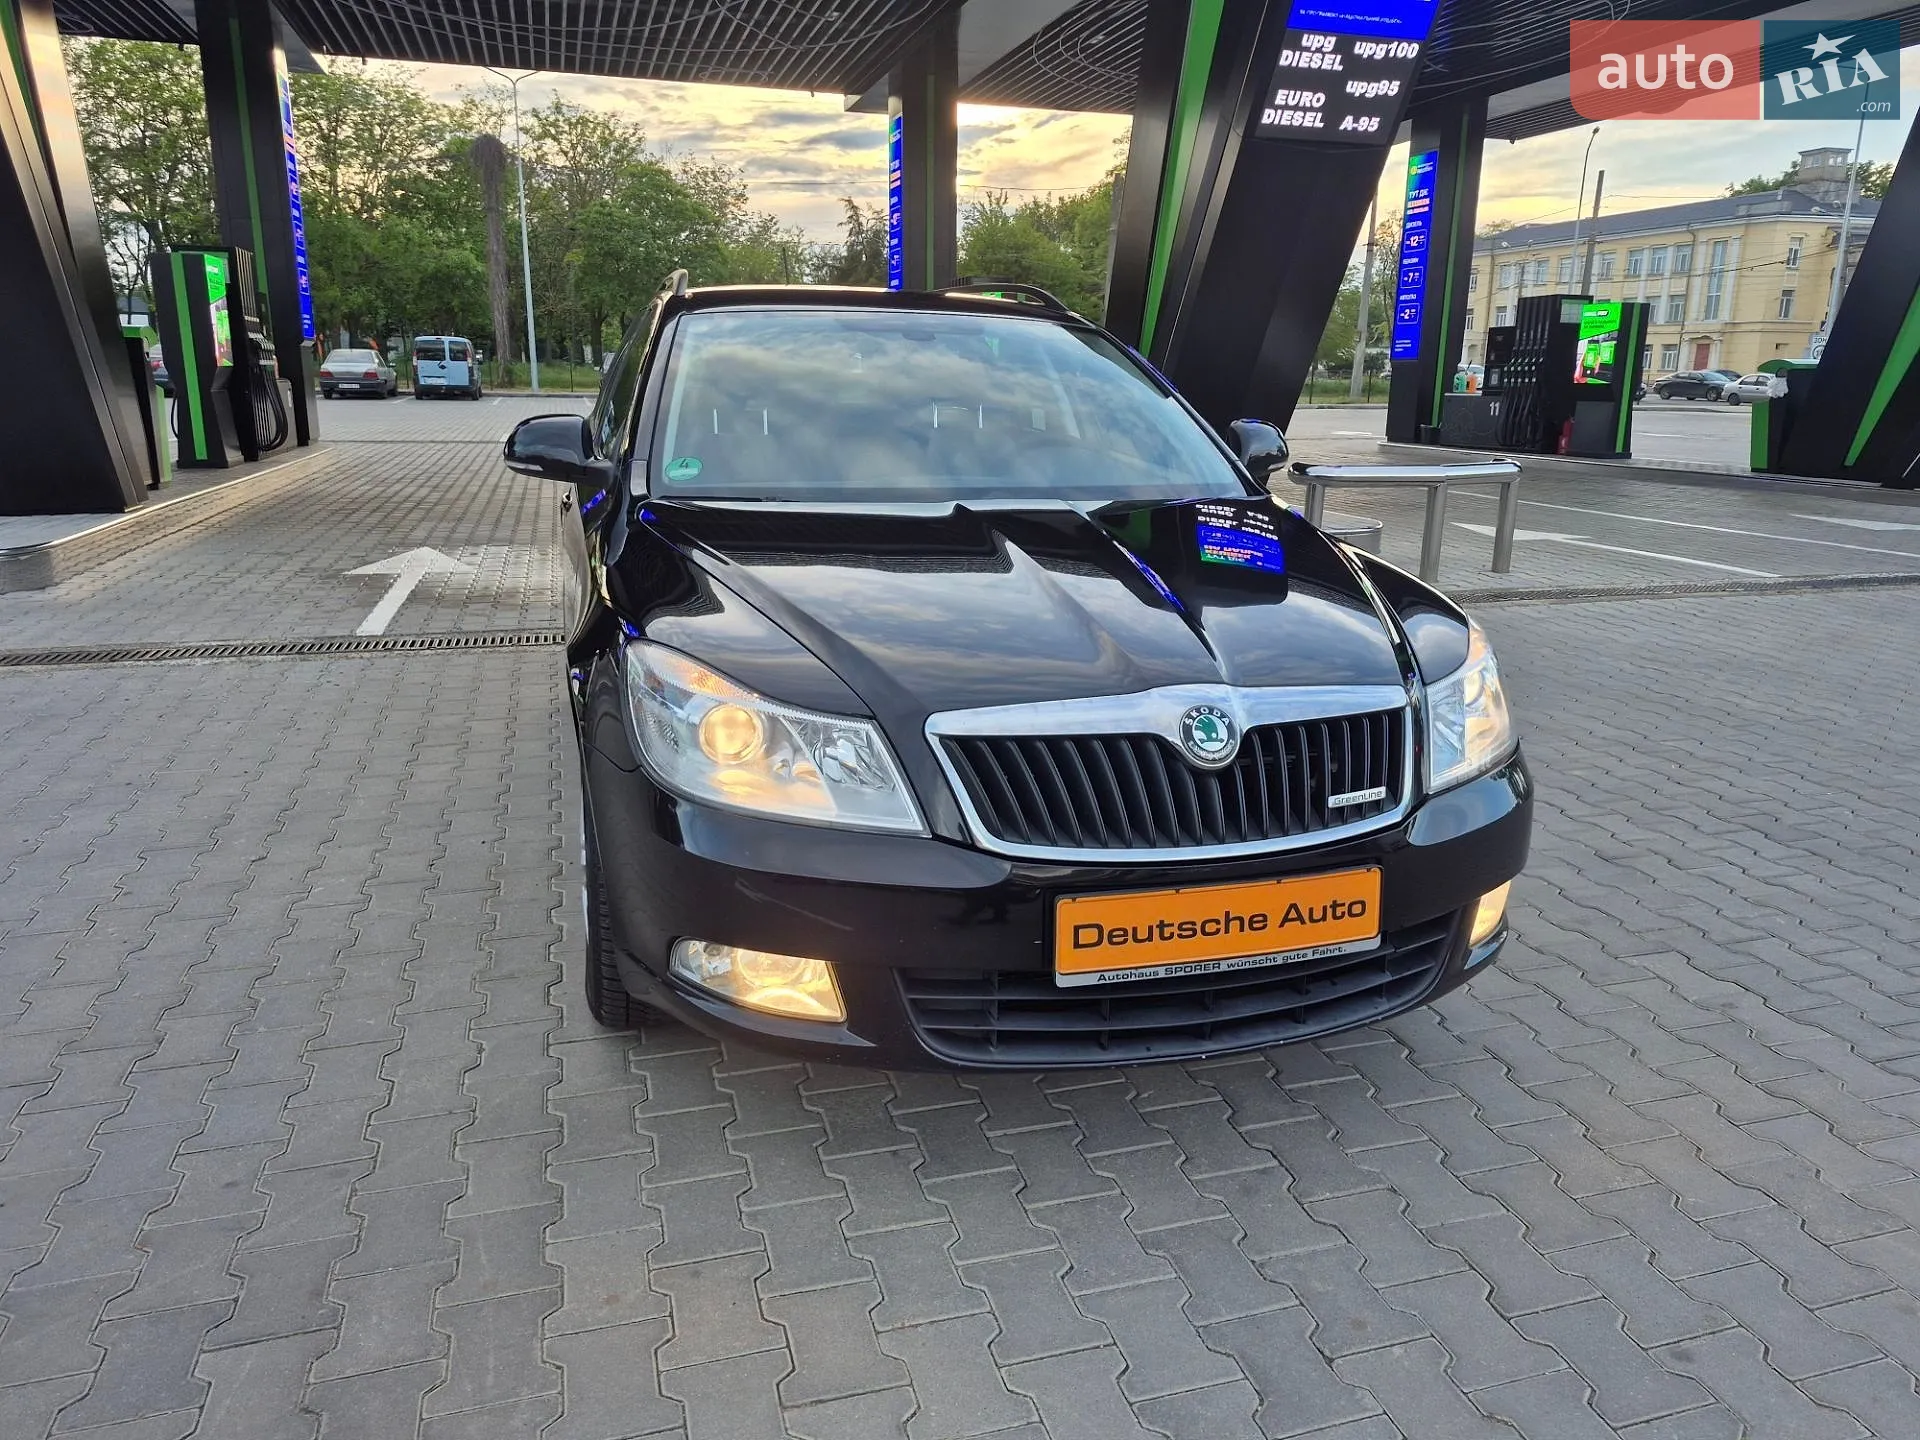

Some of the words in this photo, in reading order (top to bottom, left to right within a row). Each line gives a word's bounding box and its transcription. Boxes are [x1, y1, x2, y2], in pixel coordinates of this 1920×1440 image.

[1301, 33, 1337, 52] upg
[1353, 40, 1420, 60] upg100
[1278, 49, 1344, 72] DIESEL
[1345, 79, 1401, 98] upg95
[1274, 89, 1326, 108] EURO
[1261, 108, 1325, 129] DIESEL
[1338, 114, 1381, 132] A-95
[1489, 401, 1500, 417] 11
[678, 458, 689, 469] 4
[1335, 790, 1383, 805] GreenLine
[1072, 910, 1268, 950] Deutsche
[1278, 898, 1368, 929] Auto
[1097, 970, 1160, 983] Autohaus
[1164, 962, 1221, 976] SPORER
[1226, 956, 1278, 969] wünscht
[1282, 951, 1309, 963] gute
[1311, 946, 1347, 958] Fahrt.
